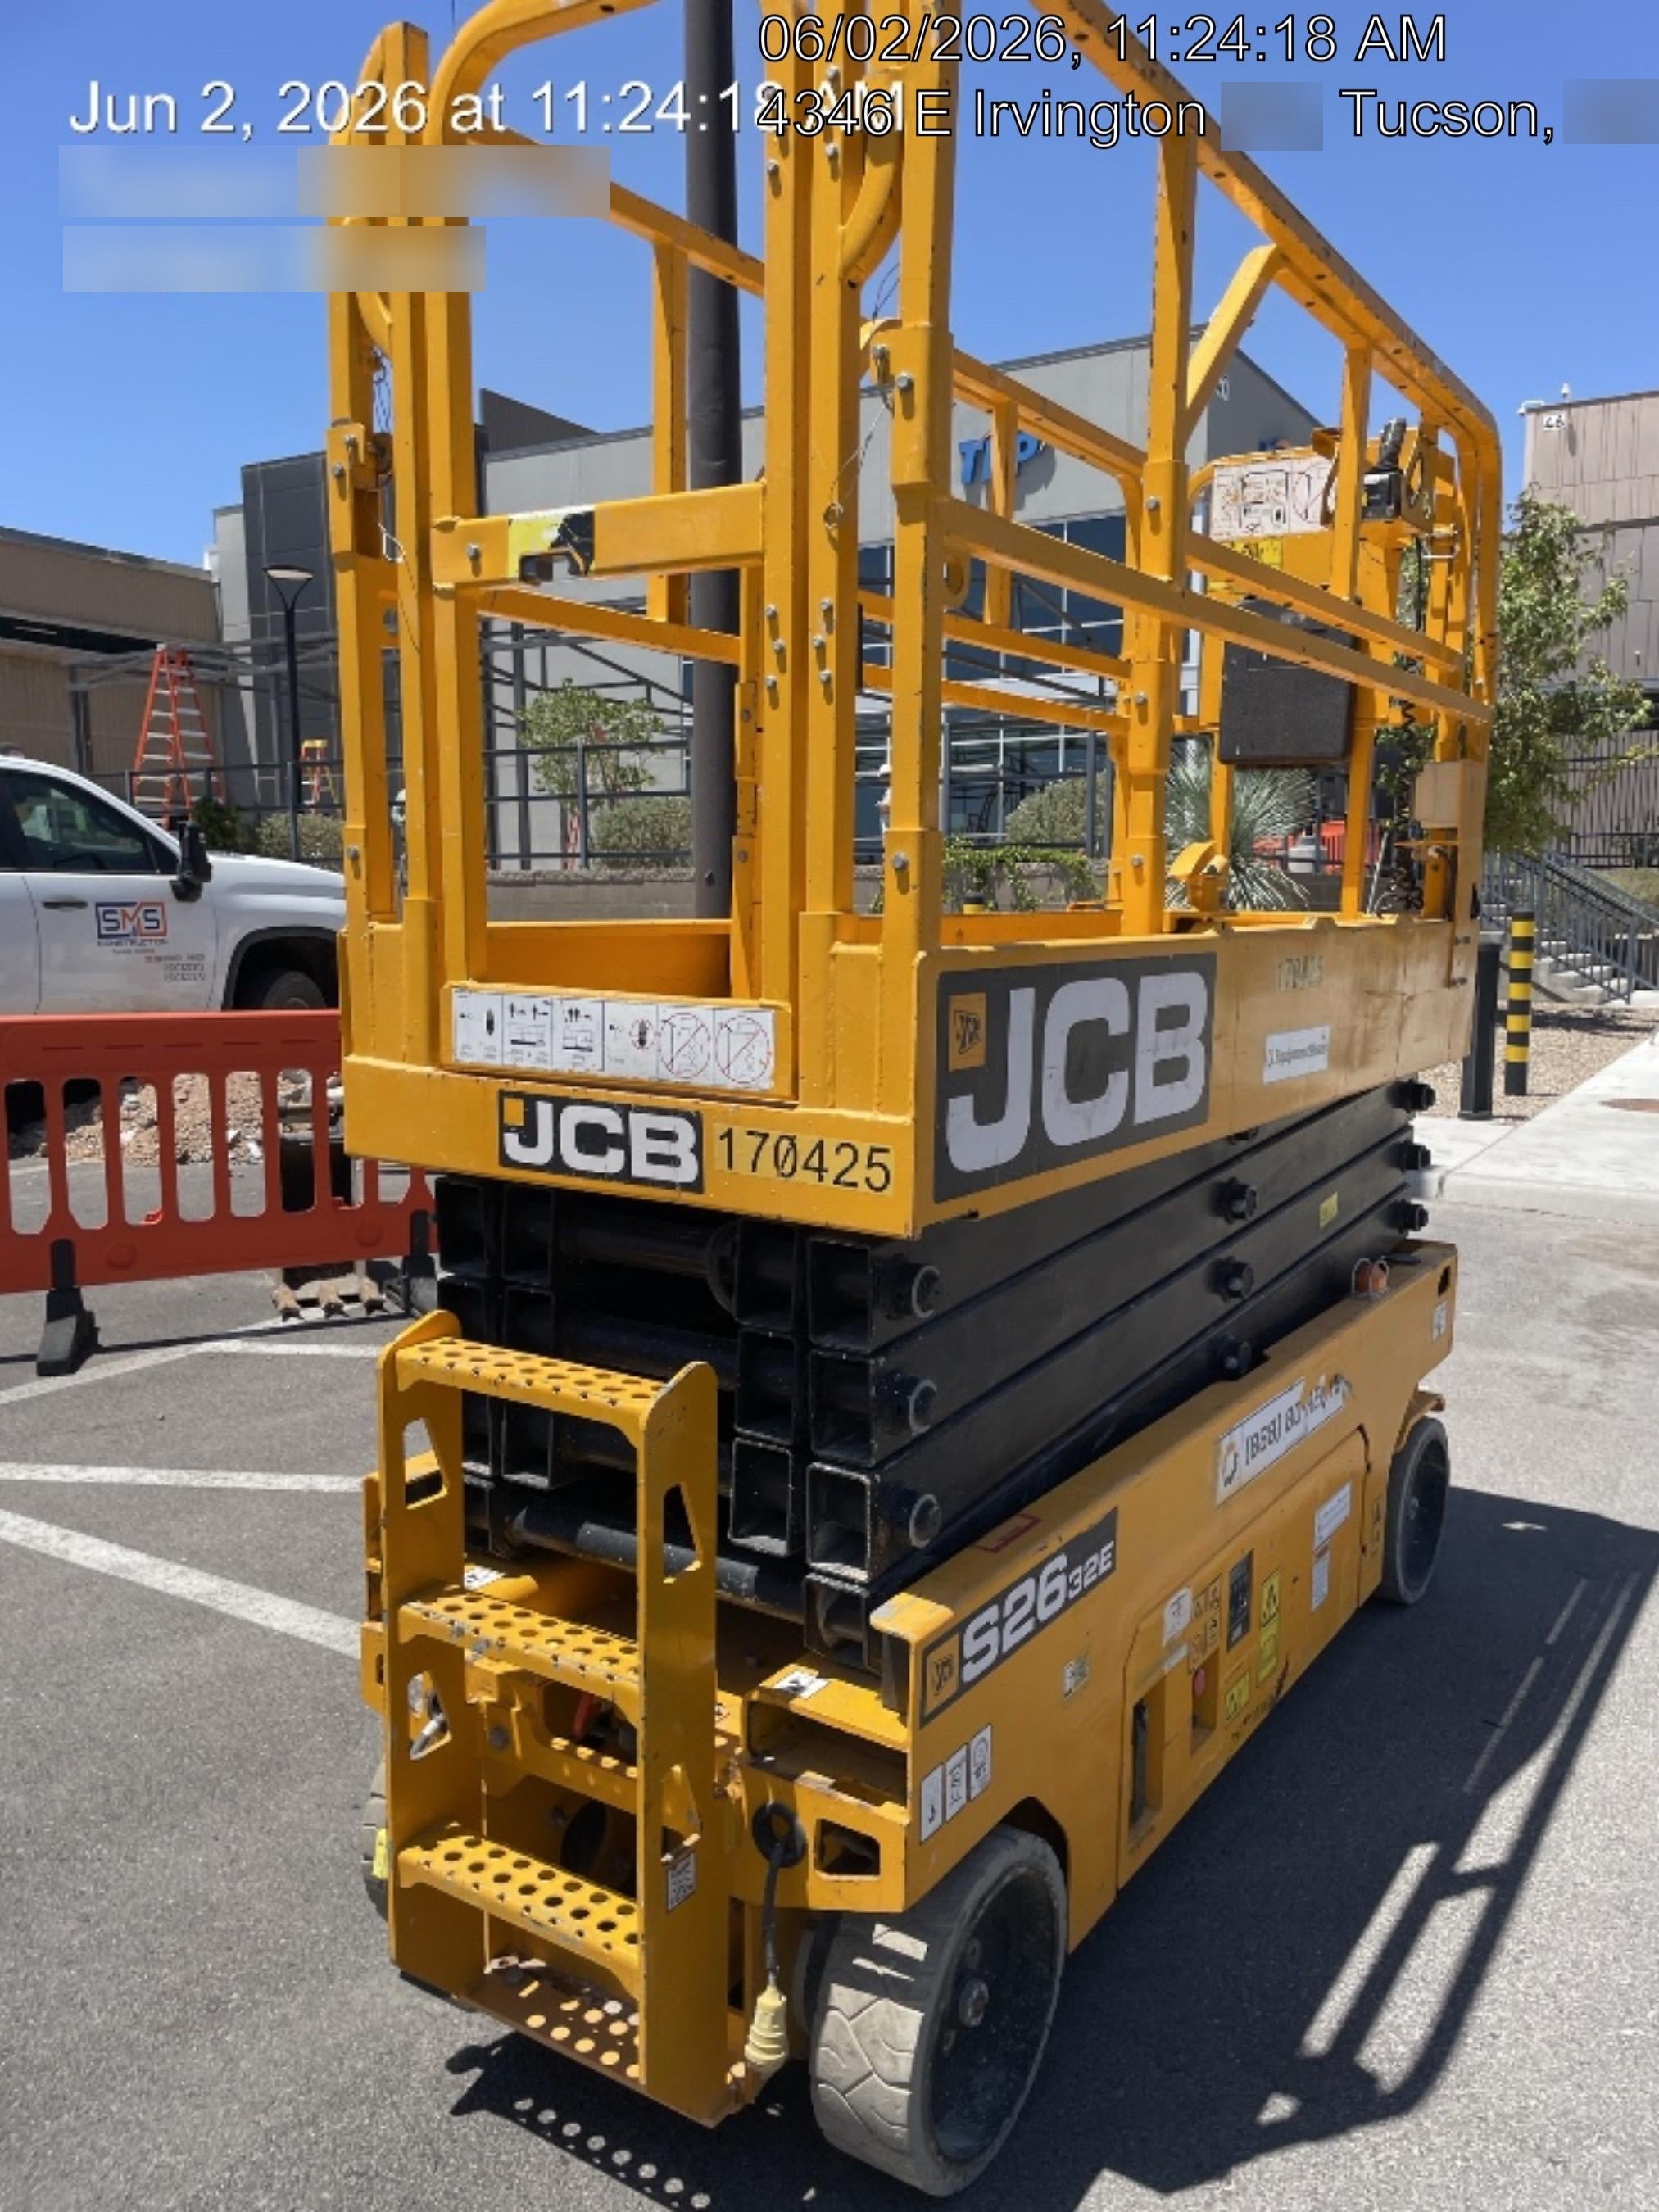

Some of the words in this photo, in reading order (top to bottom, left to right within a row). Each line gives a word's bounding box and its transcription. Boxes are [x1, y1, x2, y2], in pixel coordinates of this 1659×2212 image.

[959, 431, 1039, 484] TP
[102, 909, 160, 936] SMS
[946, 972, 1208, 1173] JCB
[503, 1100, 699, 1184] JCB
[718, 1127, 891, 1193] 170425
[962, 1552, 1067, 1685] S26
[1067, 1540, 1114, 1599] 32E
